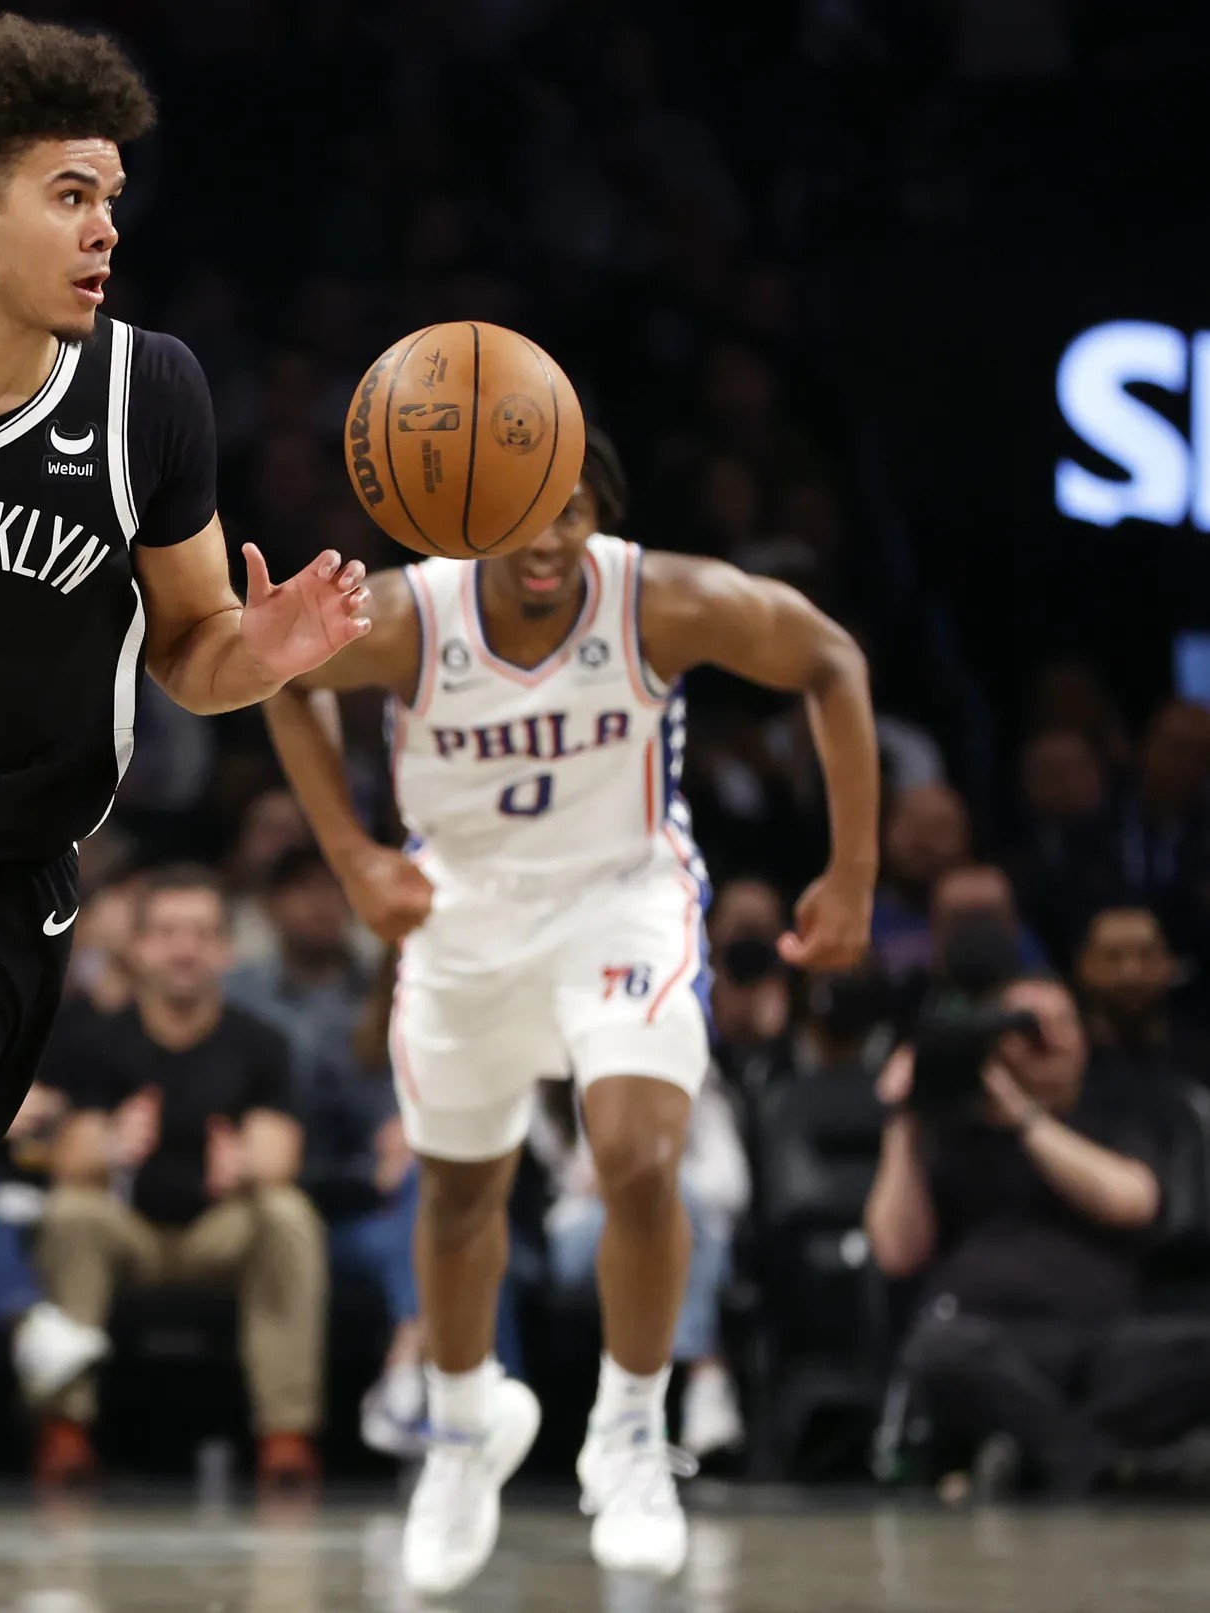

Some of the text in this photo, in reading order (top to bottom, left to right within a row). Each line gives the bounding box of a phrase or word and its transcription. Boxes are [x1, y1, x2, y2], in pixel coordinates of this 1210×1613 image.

[1055, 319, 1210, 533] S
[48, 461, 93, 477] Webull
[431, 711, 630, 762] PHILA
[601, 963, 652, 1002] 76
